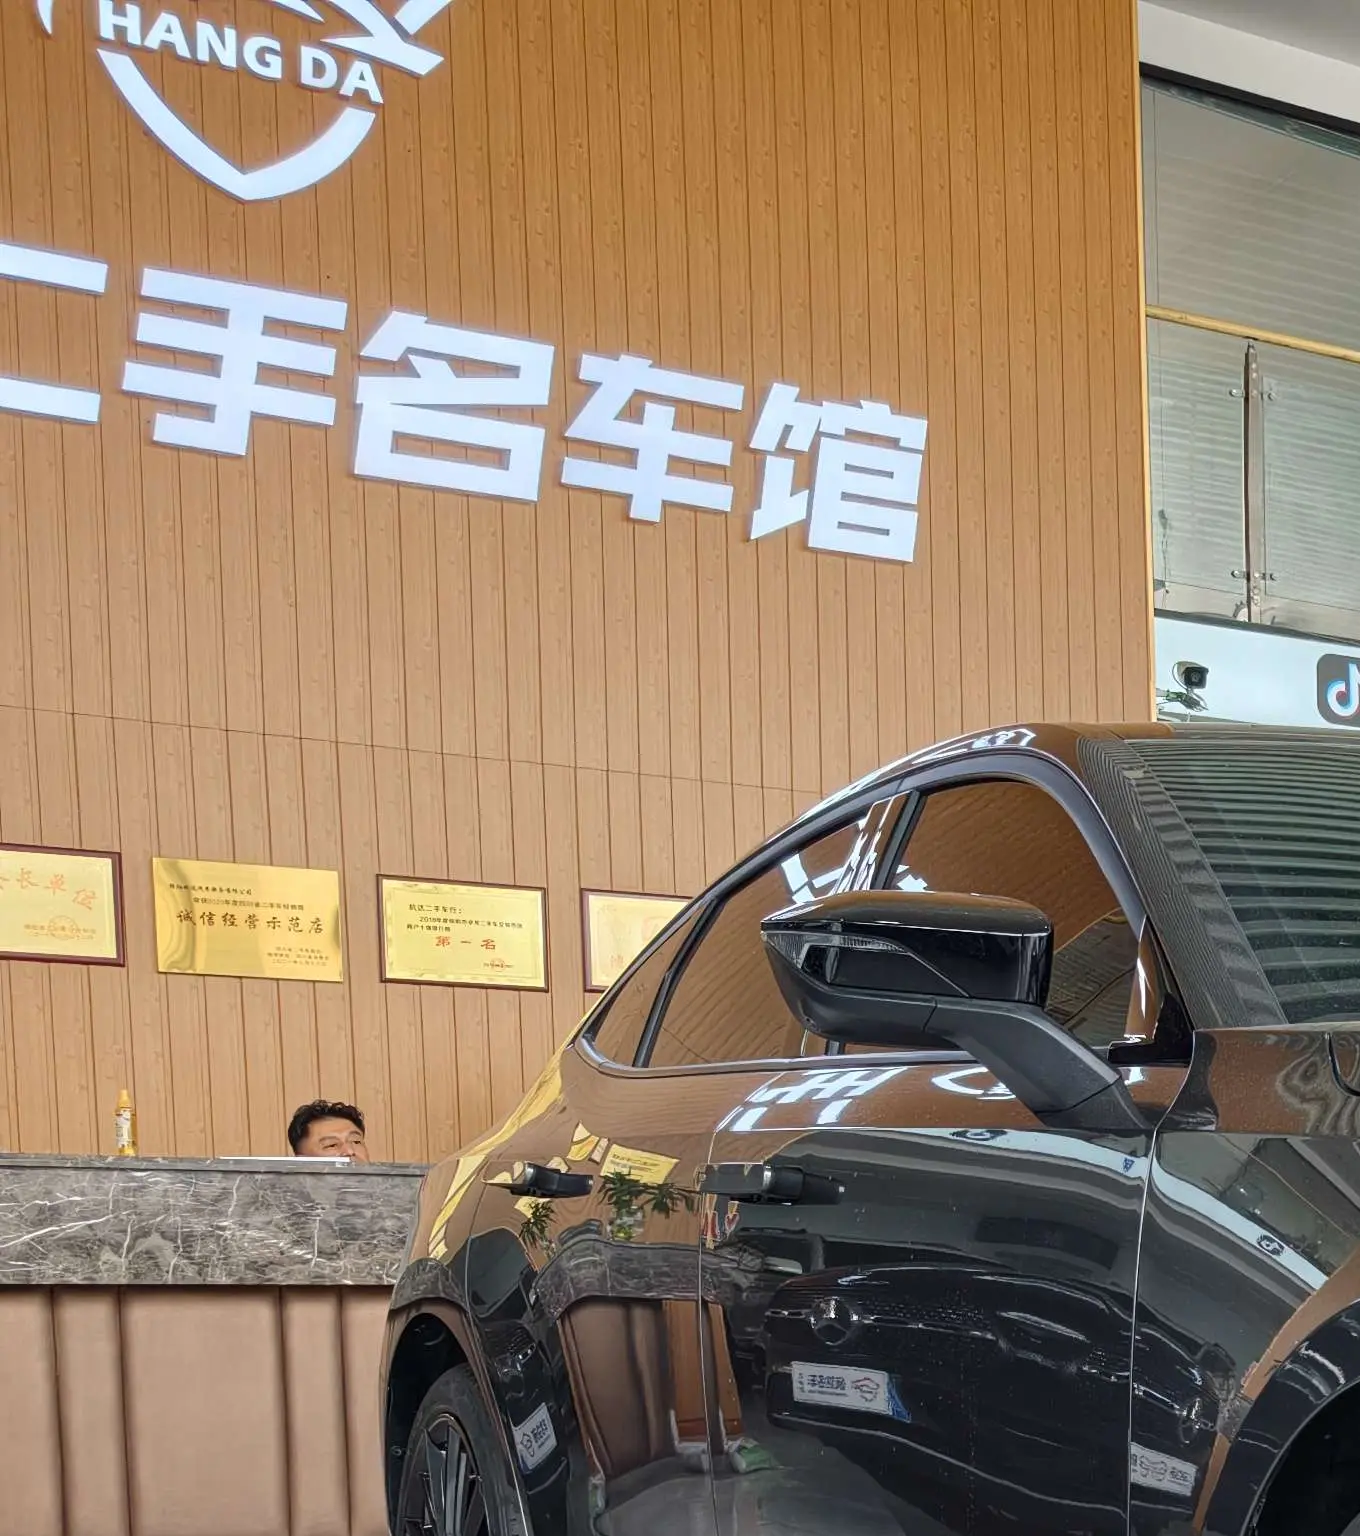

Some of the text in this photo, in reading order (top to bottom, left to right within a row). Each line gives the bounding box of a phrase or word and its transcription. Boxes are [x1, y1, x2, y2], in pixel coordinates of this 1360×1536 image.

[100, 0, 384, 104] HANG DA
[176, 908, 325, 935] 诚信经营示范店
[435, 935, 497, 951] 第一名
